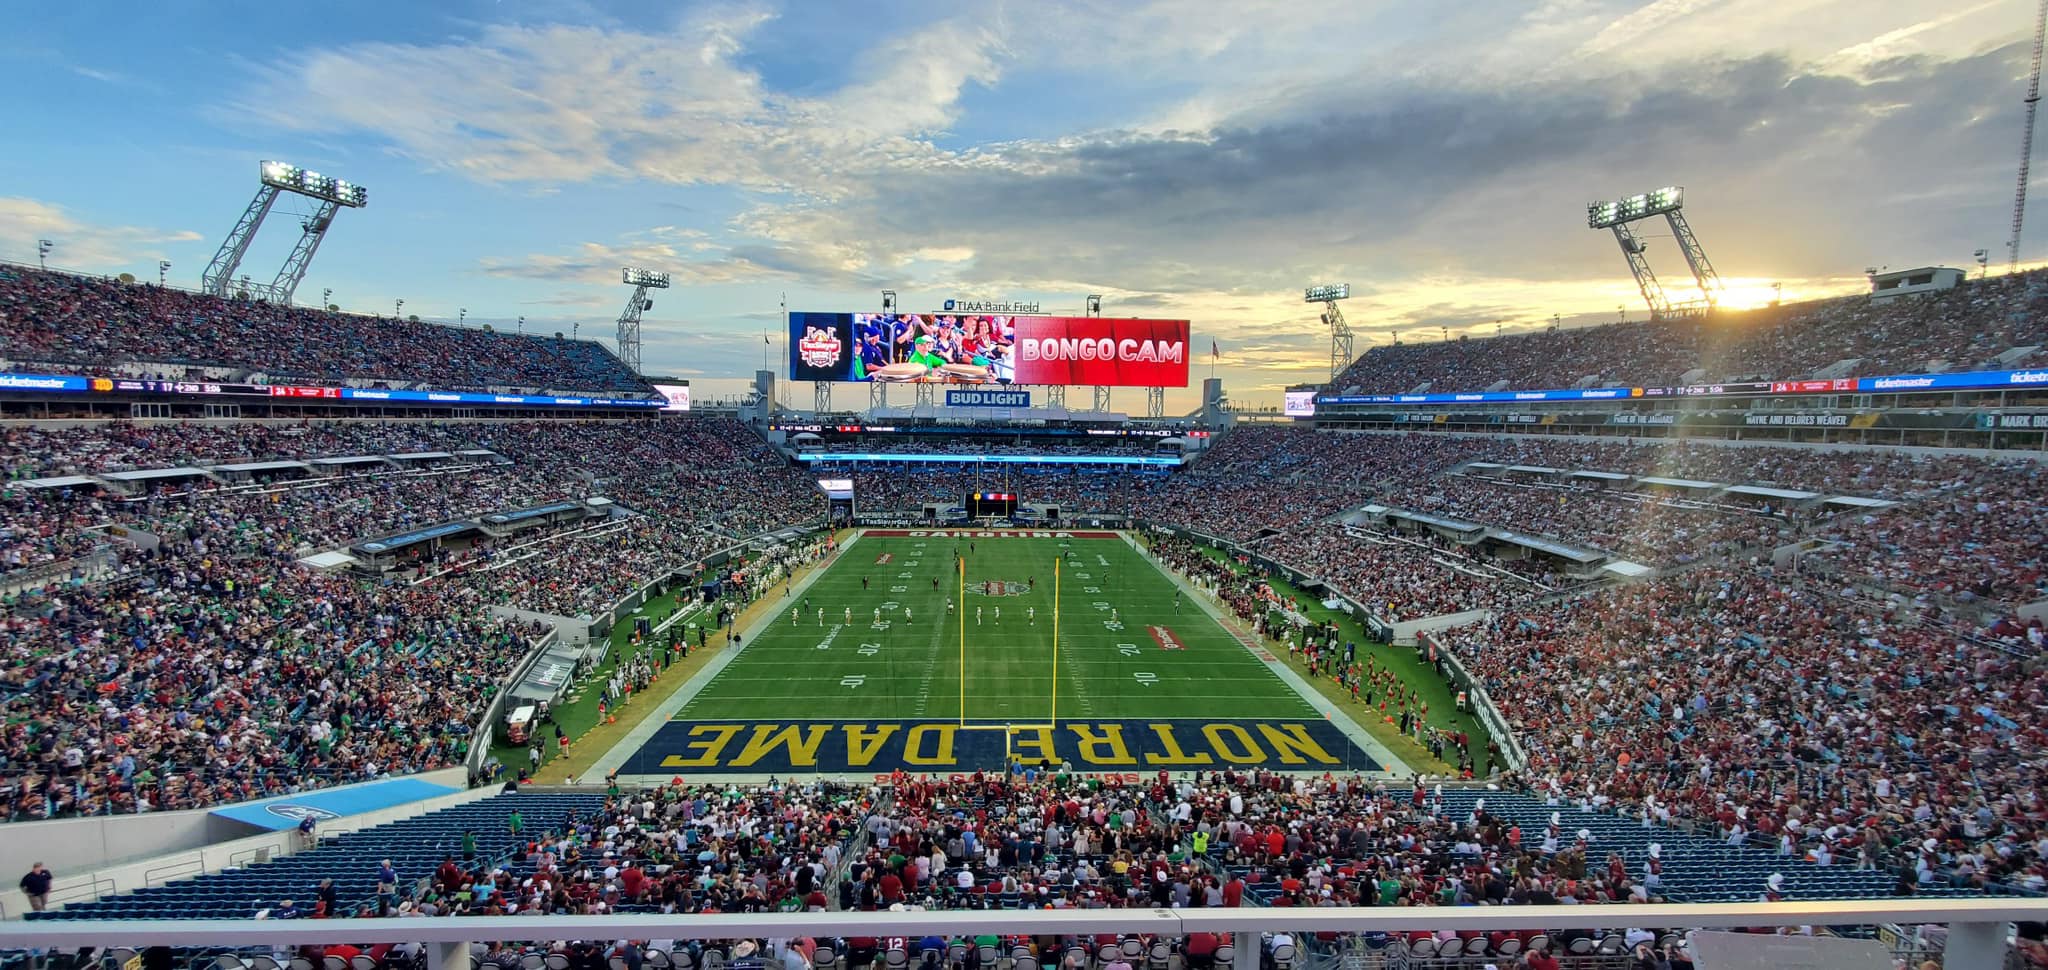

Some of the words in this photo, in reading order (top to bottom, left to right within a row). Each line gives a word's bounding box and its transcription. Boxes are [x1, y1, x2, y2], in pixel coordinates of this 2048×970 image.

[956, 300, 982, 312] TIAA
[985, 300, 1011, 312] Bank
[1014, 301, 1039, 313] Field
[1021, 338, 1116, 361] BONGO
[1118, 339, 1183, 363] CAM
[162, 382, 174, 392] 17
[1874, 377, 1937, 388] ticketmaster
[951, 393, 983, 404] BUD
[984, 393, 1025, 405] LIGHT
[1746, 415, 1769, 425] WAYNE
[1769, 415, 1784, 425] AND
[1784, 415, 1815, 425] DELORES
[1817, 415, 1847, 426] WEAVER
[2000, 415, 2030, 427] MARK
[659, 724, 965, 767] DAME
[1009, 723, 1342, 766] NOTRE
[887, 937, 904, 951] 12
